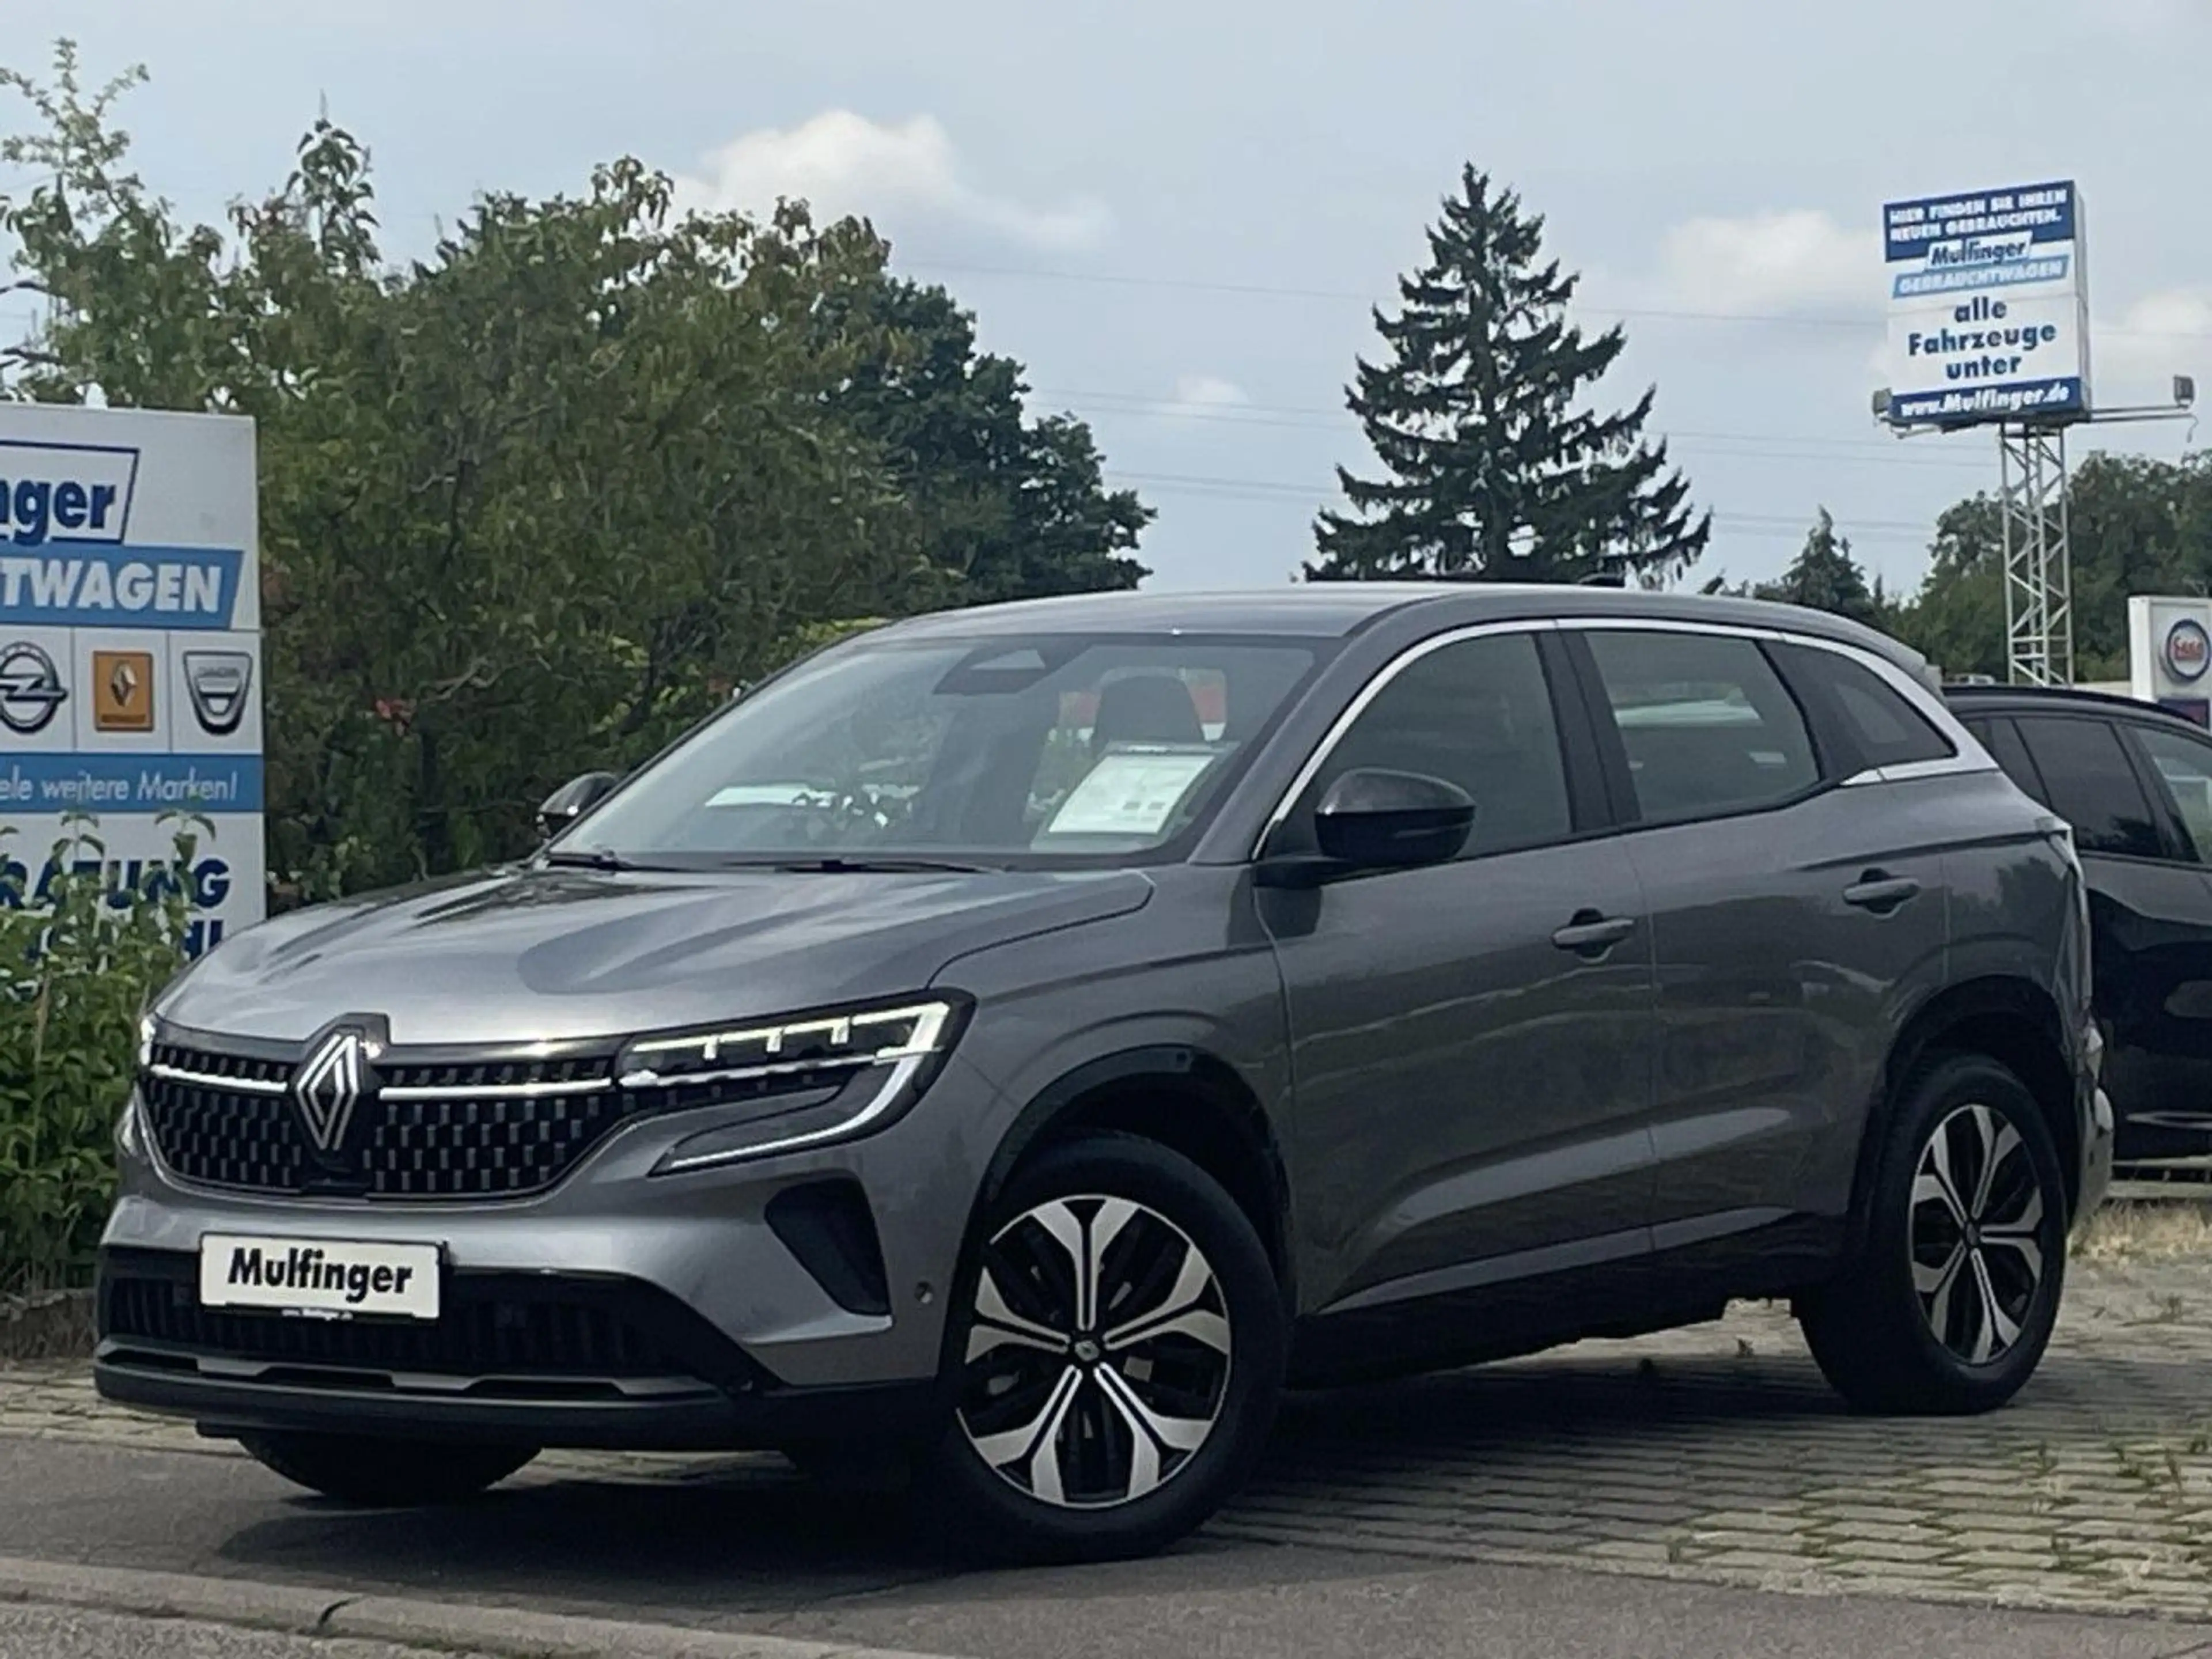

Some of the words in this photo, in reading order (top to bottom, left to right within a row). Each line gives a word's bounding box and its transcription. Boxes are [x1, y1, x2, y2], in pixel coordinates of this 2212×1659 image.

[1931, 238, 2027, 265] Mulfinger
[1955, 296, 2008, 323] alle
[1908, 324, 2056, 356] Fahrzeuge
[1946, 355, 2022, 380] unter
[1901, 382, 2070, 417] www.Mulfinger.de
[41, 770, 129, 802] weitere
[137, 766, 238, 801] Marken!
[228, 1247, 414, 1304] Mulfinger
